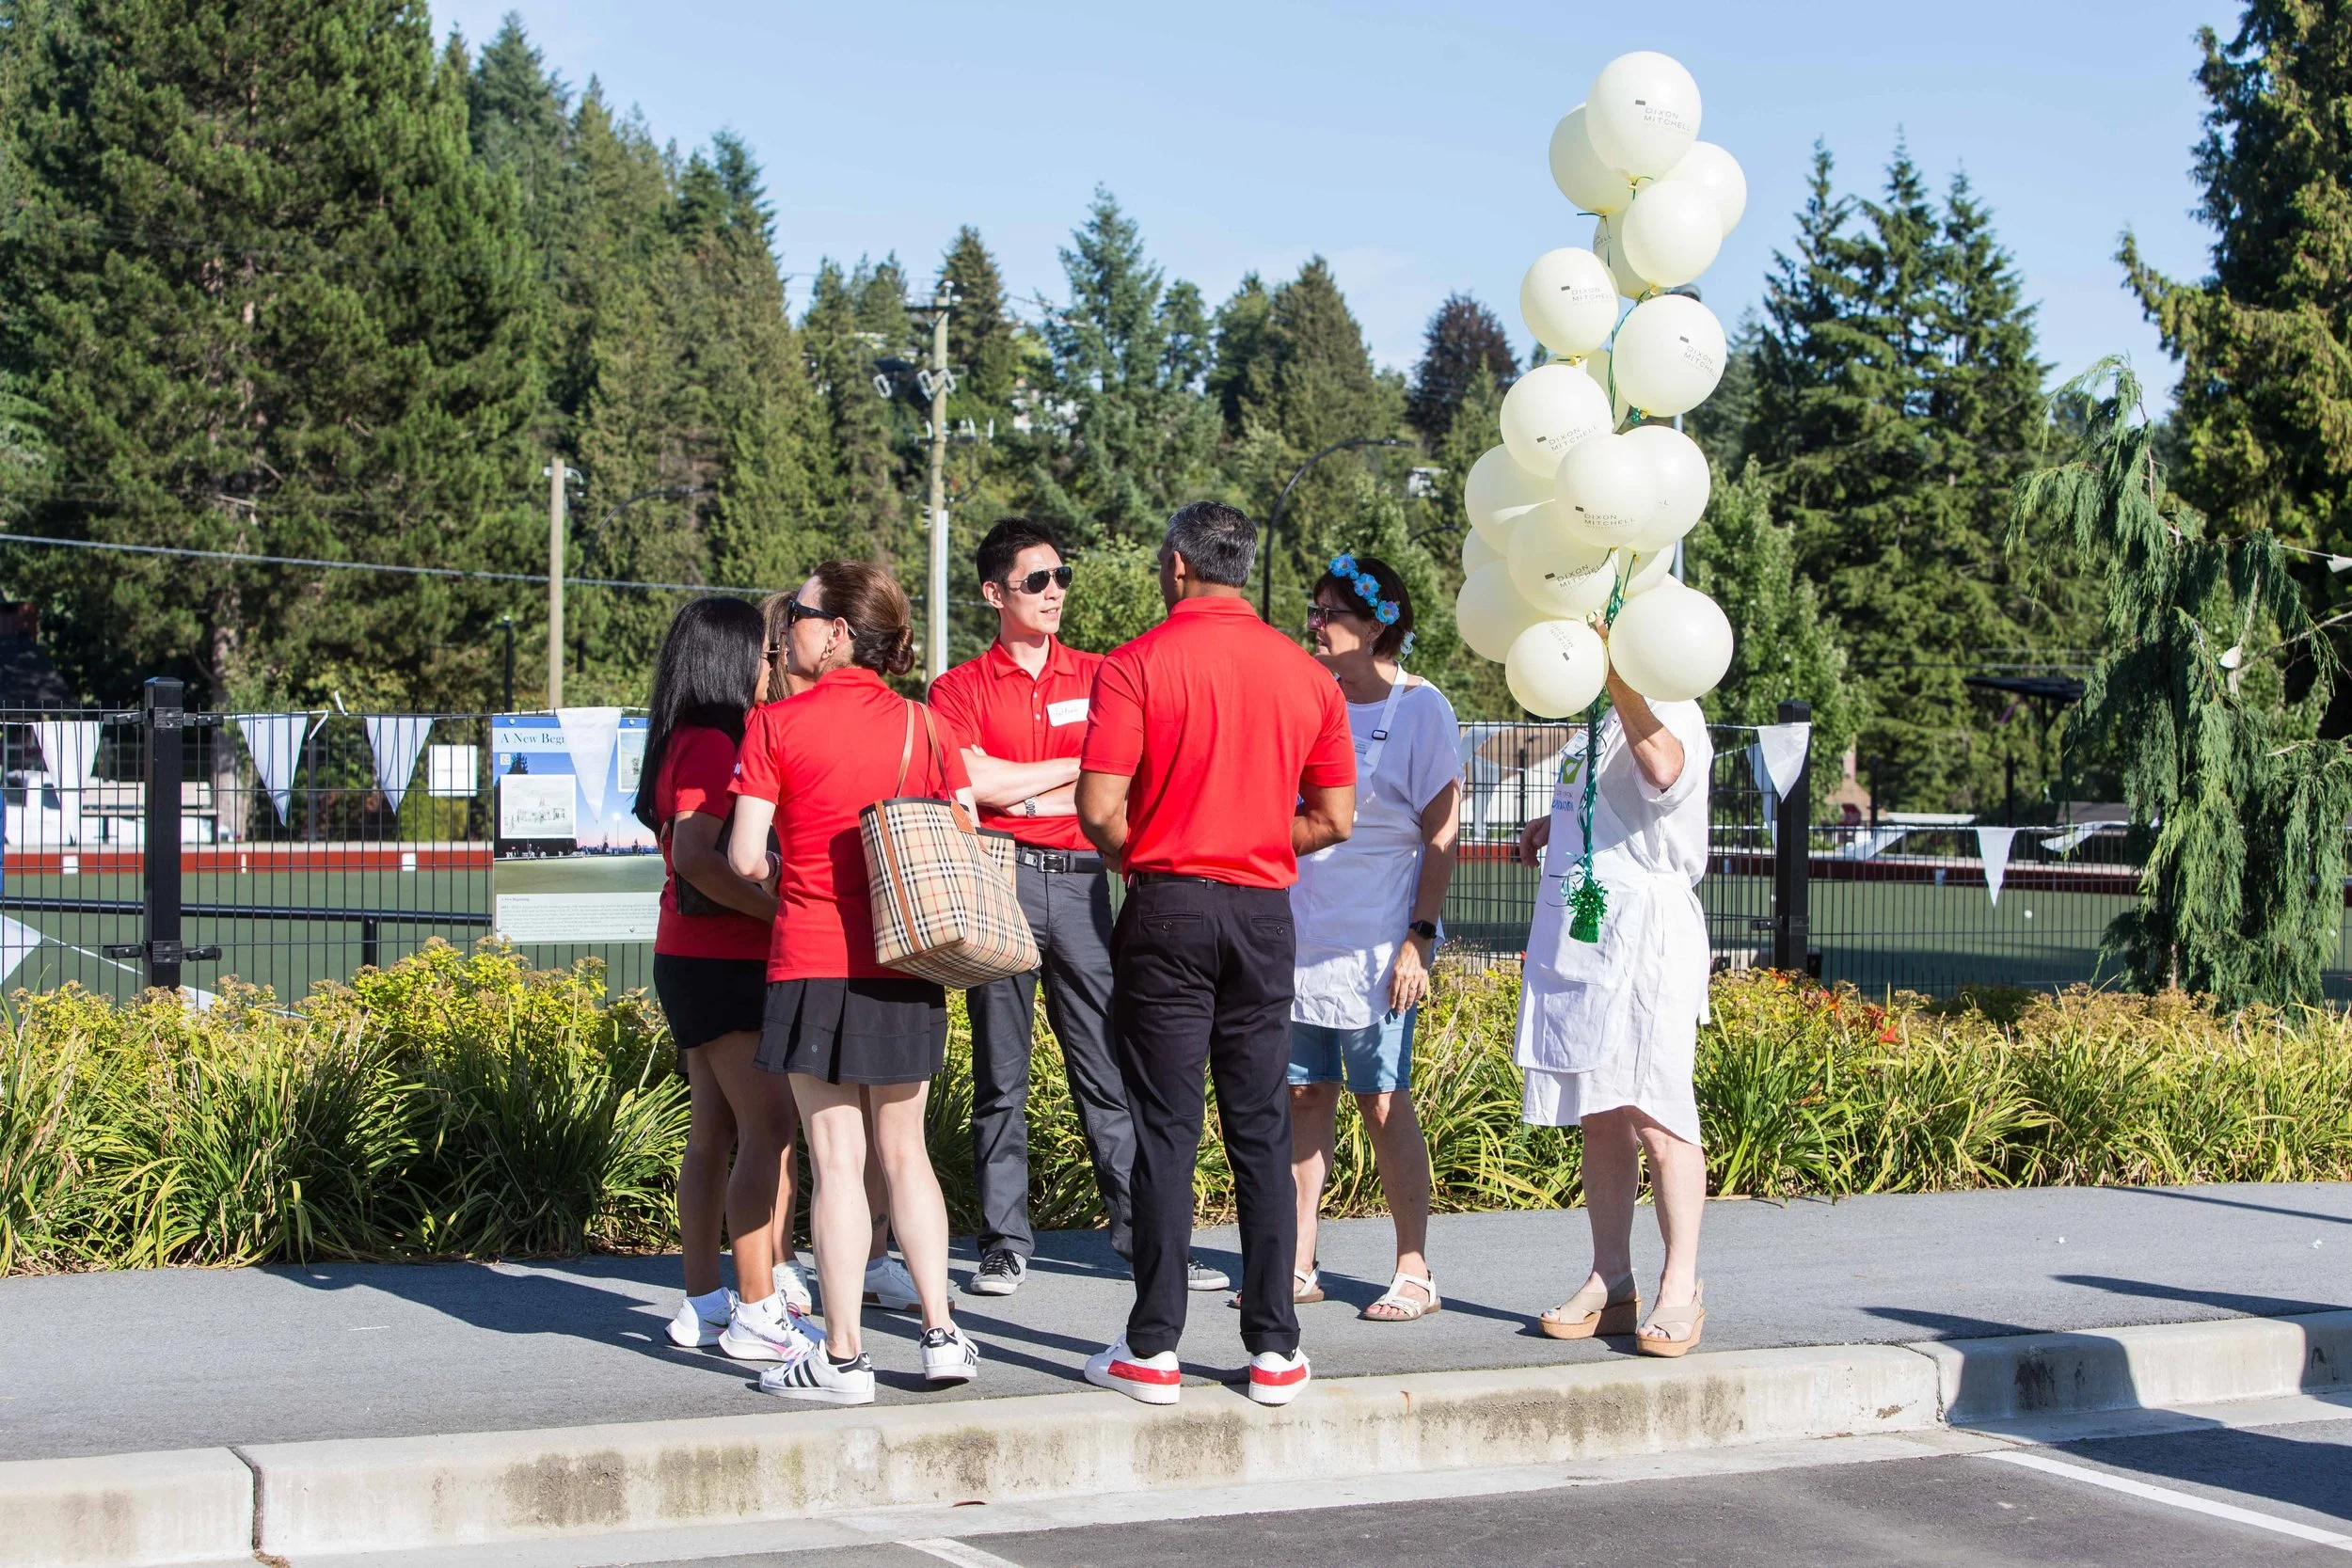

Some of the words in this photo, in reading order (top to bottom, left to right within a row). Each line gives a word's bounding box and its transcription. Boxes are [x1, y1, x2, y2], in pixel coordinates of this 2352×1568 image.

[1645, 107, 1678, 119] DIXON
[1644, 115, 1691, 131] MITCHELL
[1571, 287, 1601, 295] DIXON
[1687, 345, 1712, 365] DIXON
[1549, 428, 1581, 445] DIXON
[1584, 517, 1635, 526] MITCHELL
[1557, 564, 1589, 581] DIXON
[501, 733, 509, 743] A
[514, 733, 537, 743] New
